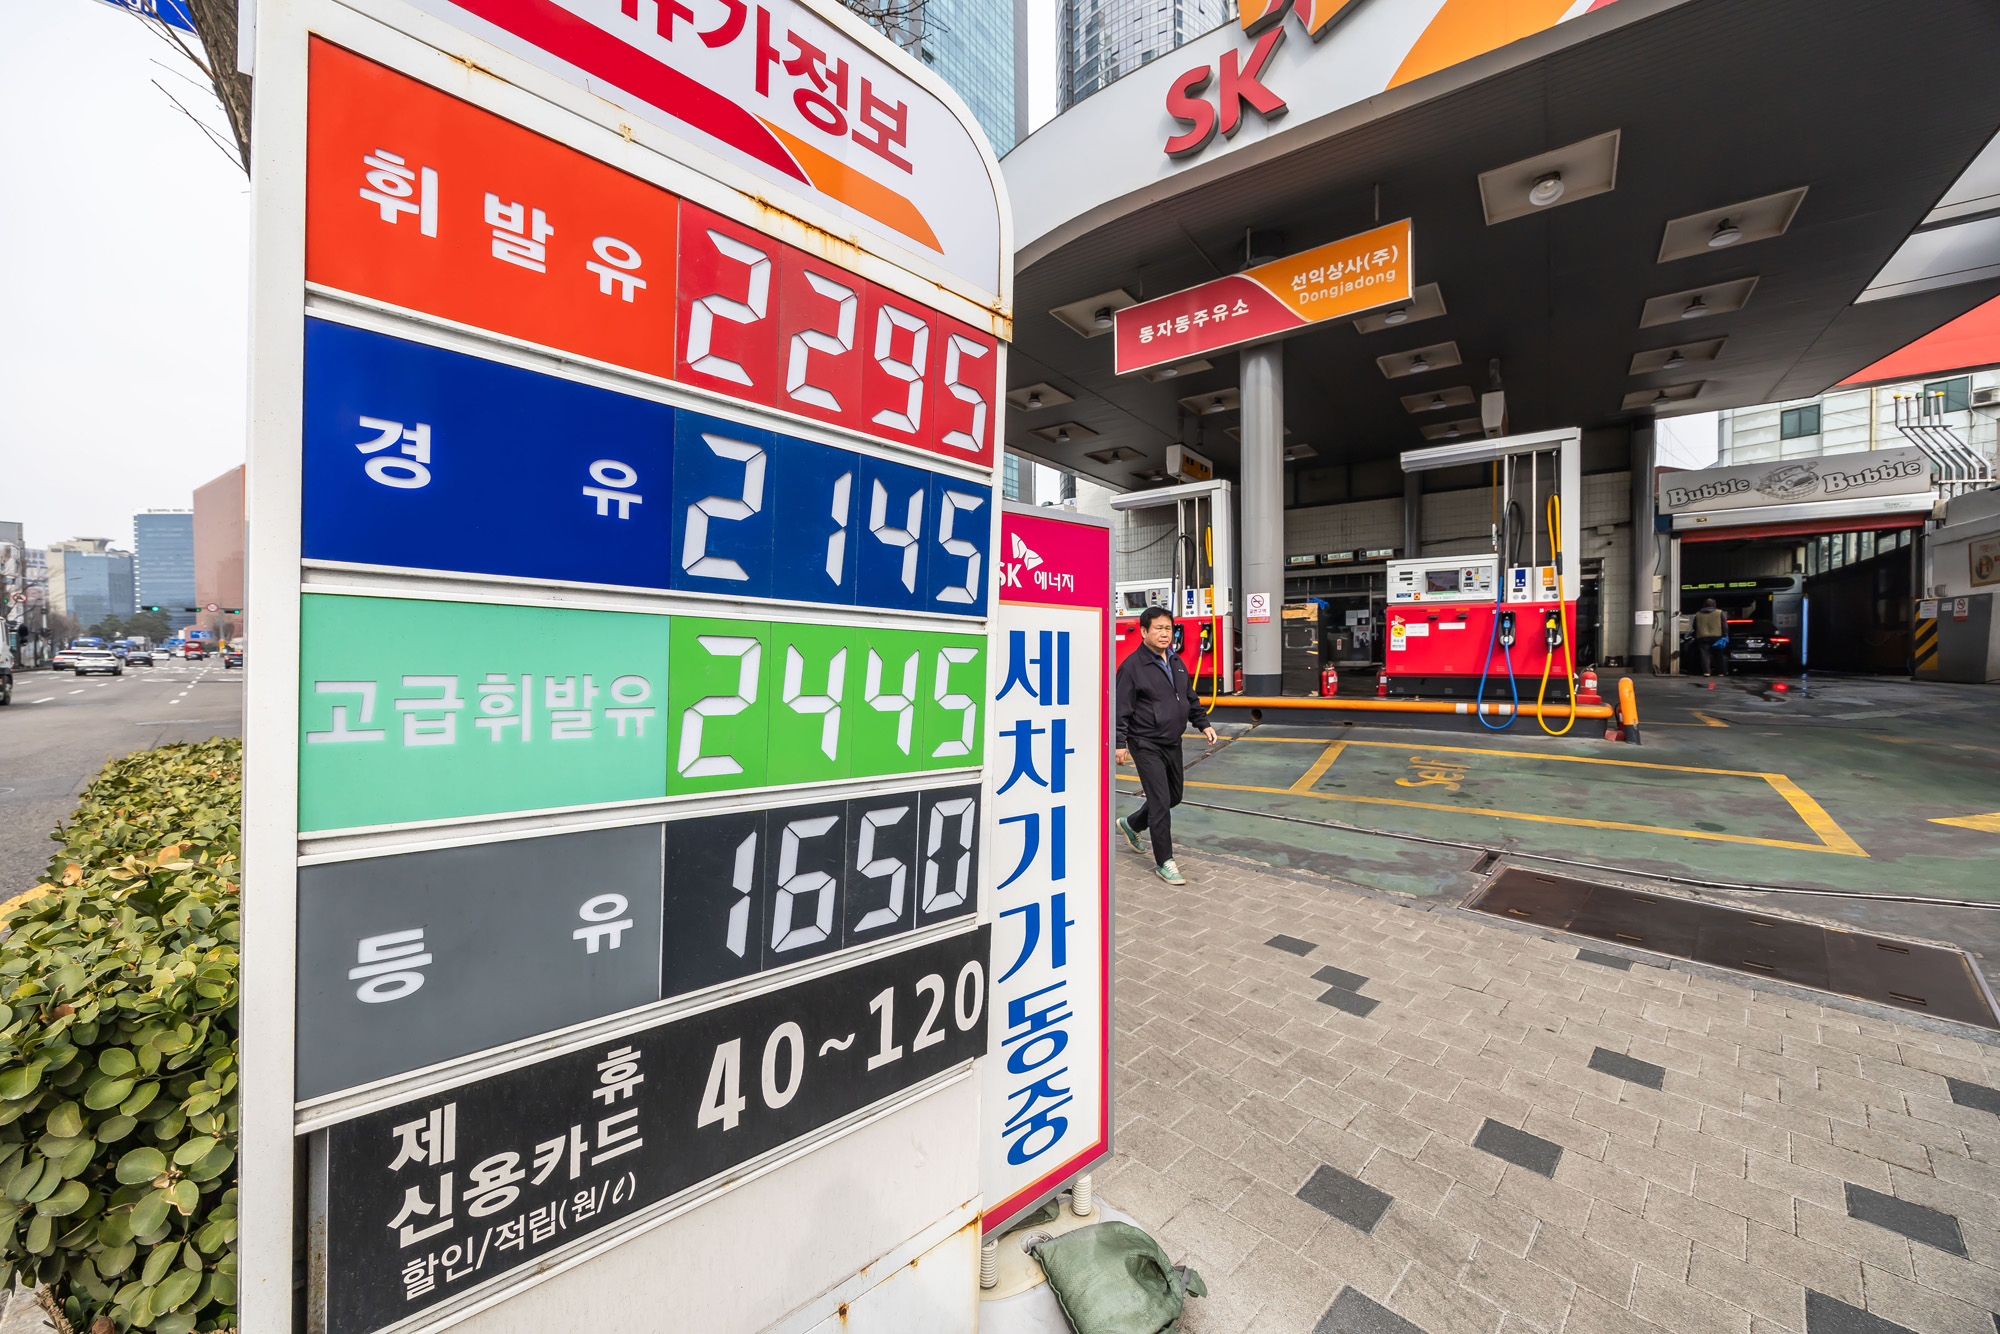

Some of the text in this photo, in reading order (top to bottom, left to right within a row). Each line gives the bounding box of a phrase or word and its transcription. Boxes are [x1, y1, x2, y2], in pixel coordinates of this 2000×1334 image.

[1164, 25, 1289, 159] SK
[1290, 245, 1399, 291] 선익상사(주)
[1299, 269, 1396, 305] Dongjadong
[685, 228, 989, 452] 2295
[1138, 298, 1250, 344] 동자동주유소
[682, 433, 985, 604] 2145
[1667, 461, 1924, 508] Bubble Bubble
[1034, 570, 1074, 593] 에너지
[306, 673, 656, 747] 고급휘발유
[676, 635, 980, 778] 2445
[726, 797, 975, 958] 1650
[387, 1107, 644, 1249] 신용카드
